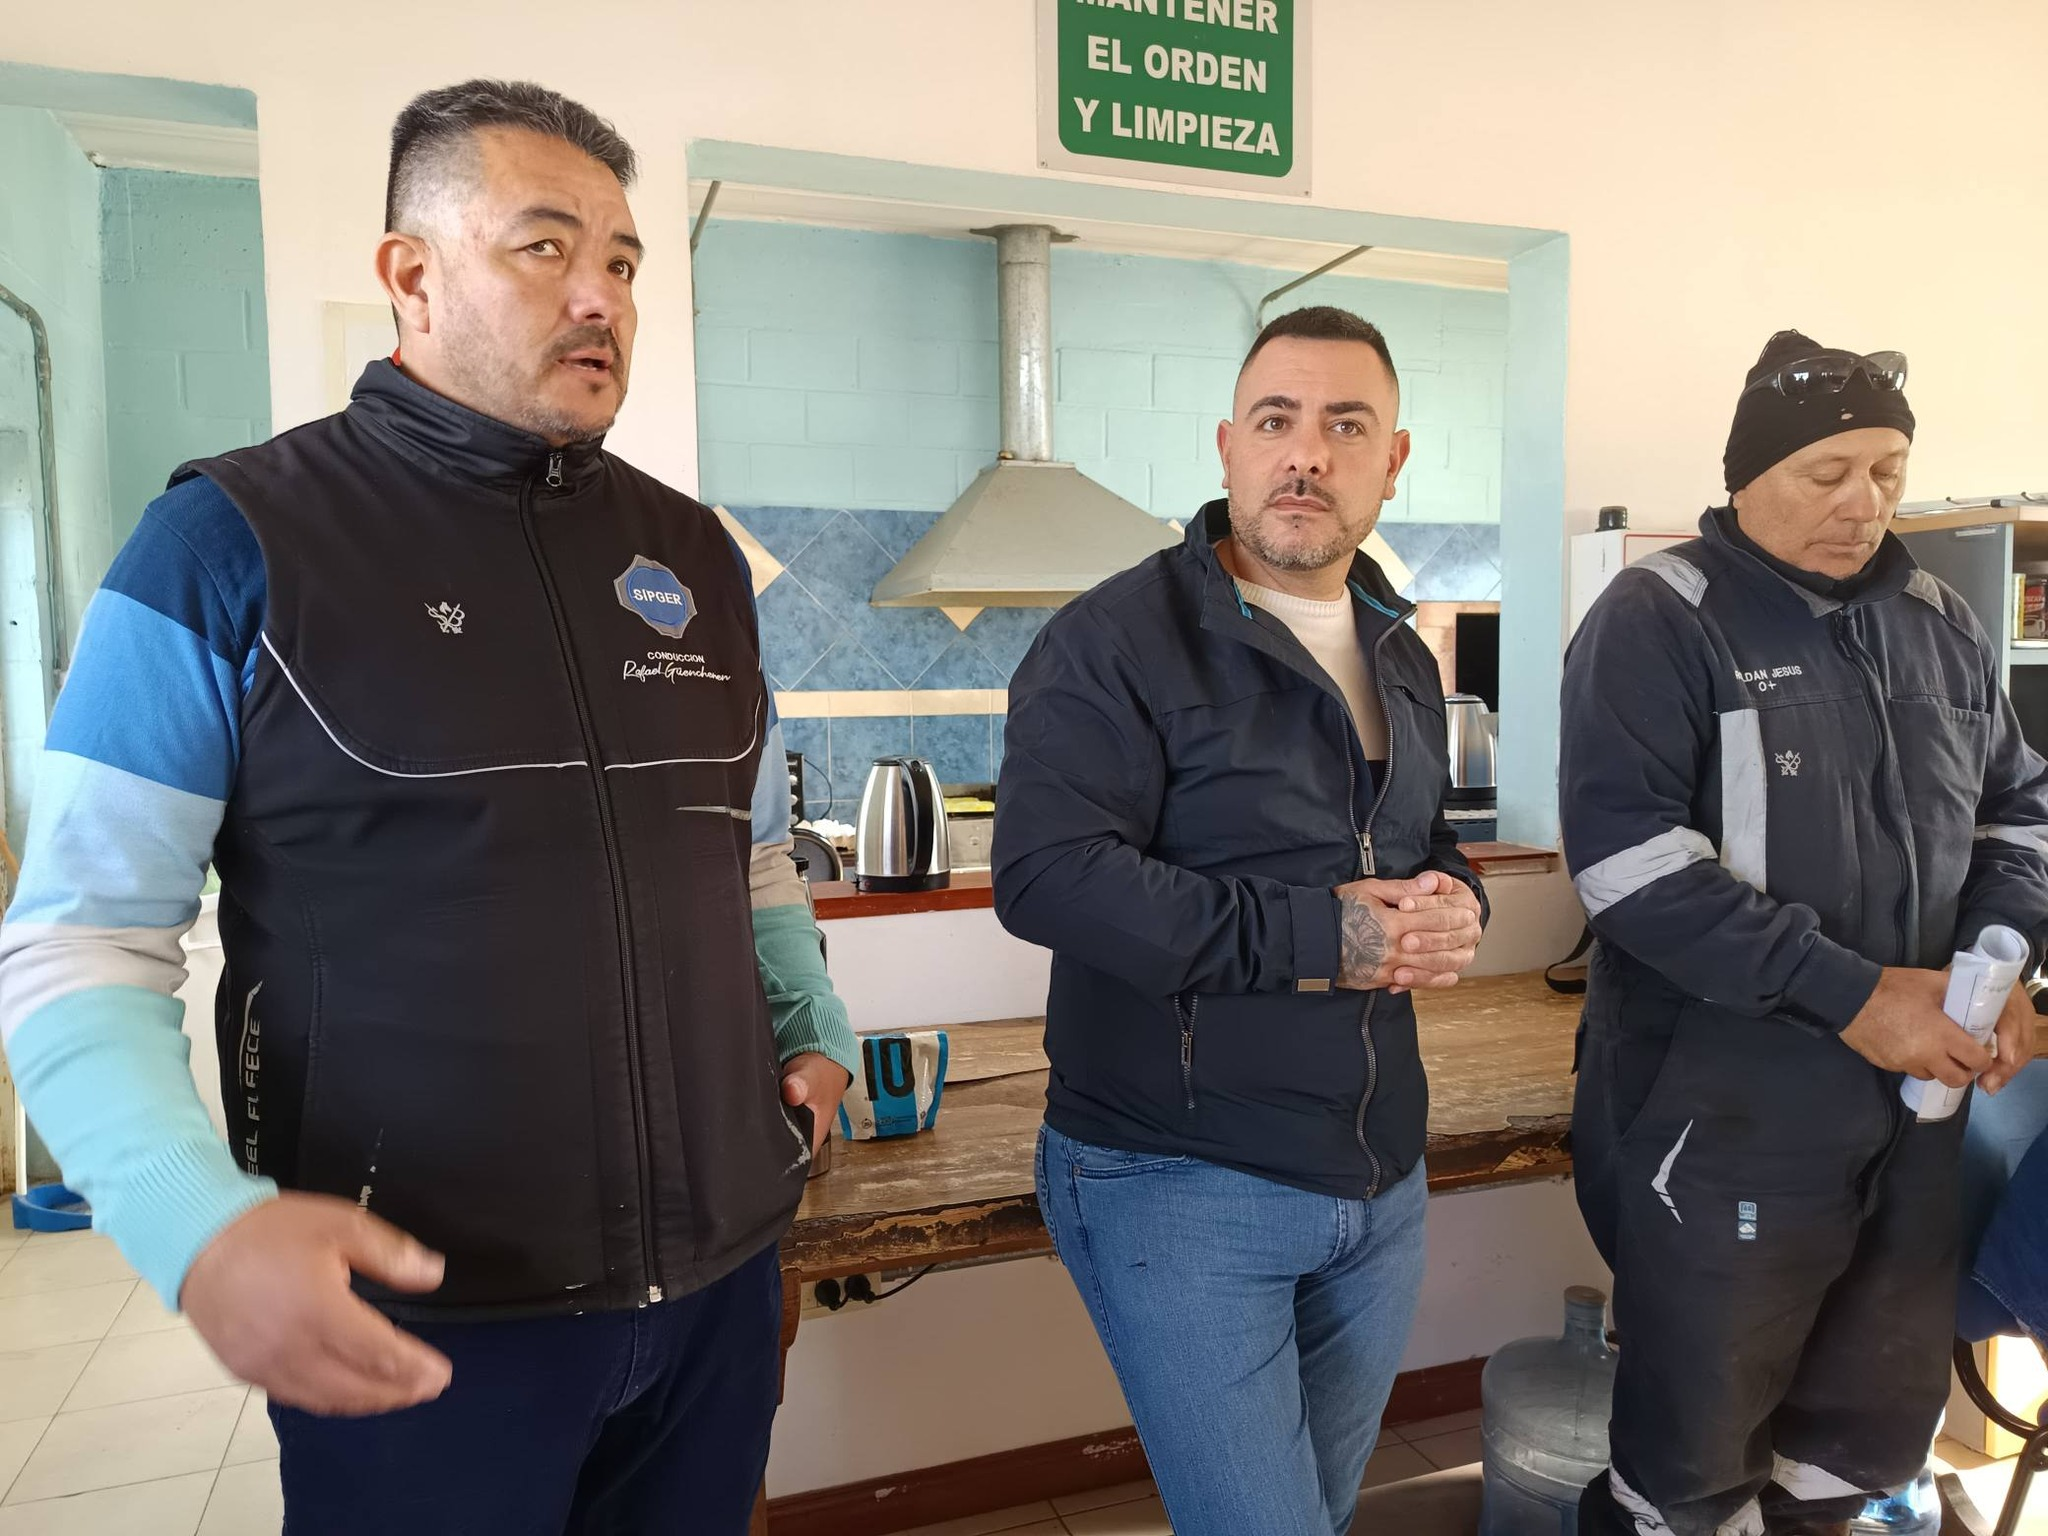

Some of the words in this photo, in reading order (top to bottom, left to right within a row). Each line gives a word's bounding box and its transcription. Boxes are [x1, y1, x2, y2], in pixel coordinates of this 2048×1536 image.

[1076, 0, 1279, 34] TENER
[1087, 35, 1132, 75] EL
[1143, 44, 1267, 94] ORDEN
[1073, 97, 1100, 133] Y
[1112, 102, 1280, 156] LIMPIEZA
[633, 588, 683, 606] SIPGER
[647, 651, 705, 664] CONDUCCION
[623, 660, 661, 682] Rafael
[1771, 665, 1803, 679] JESUS
